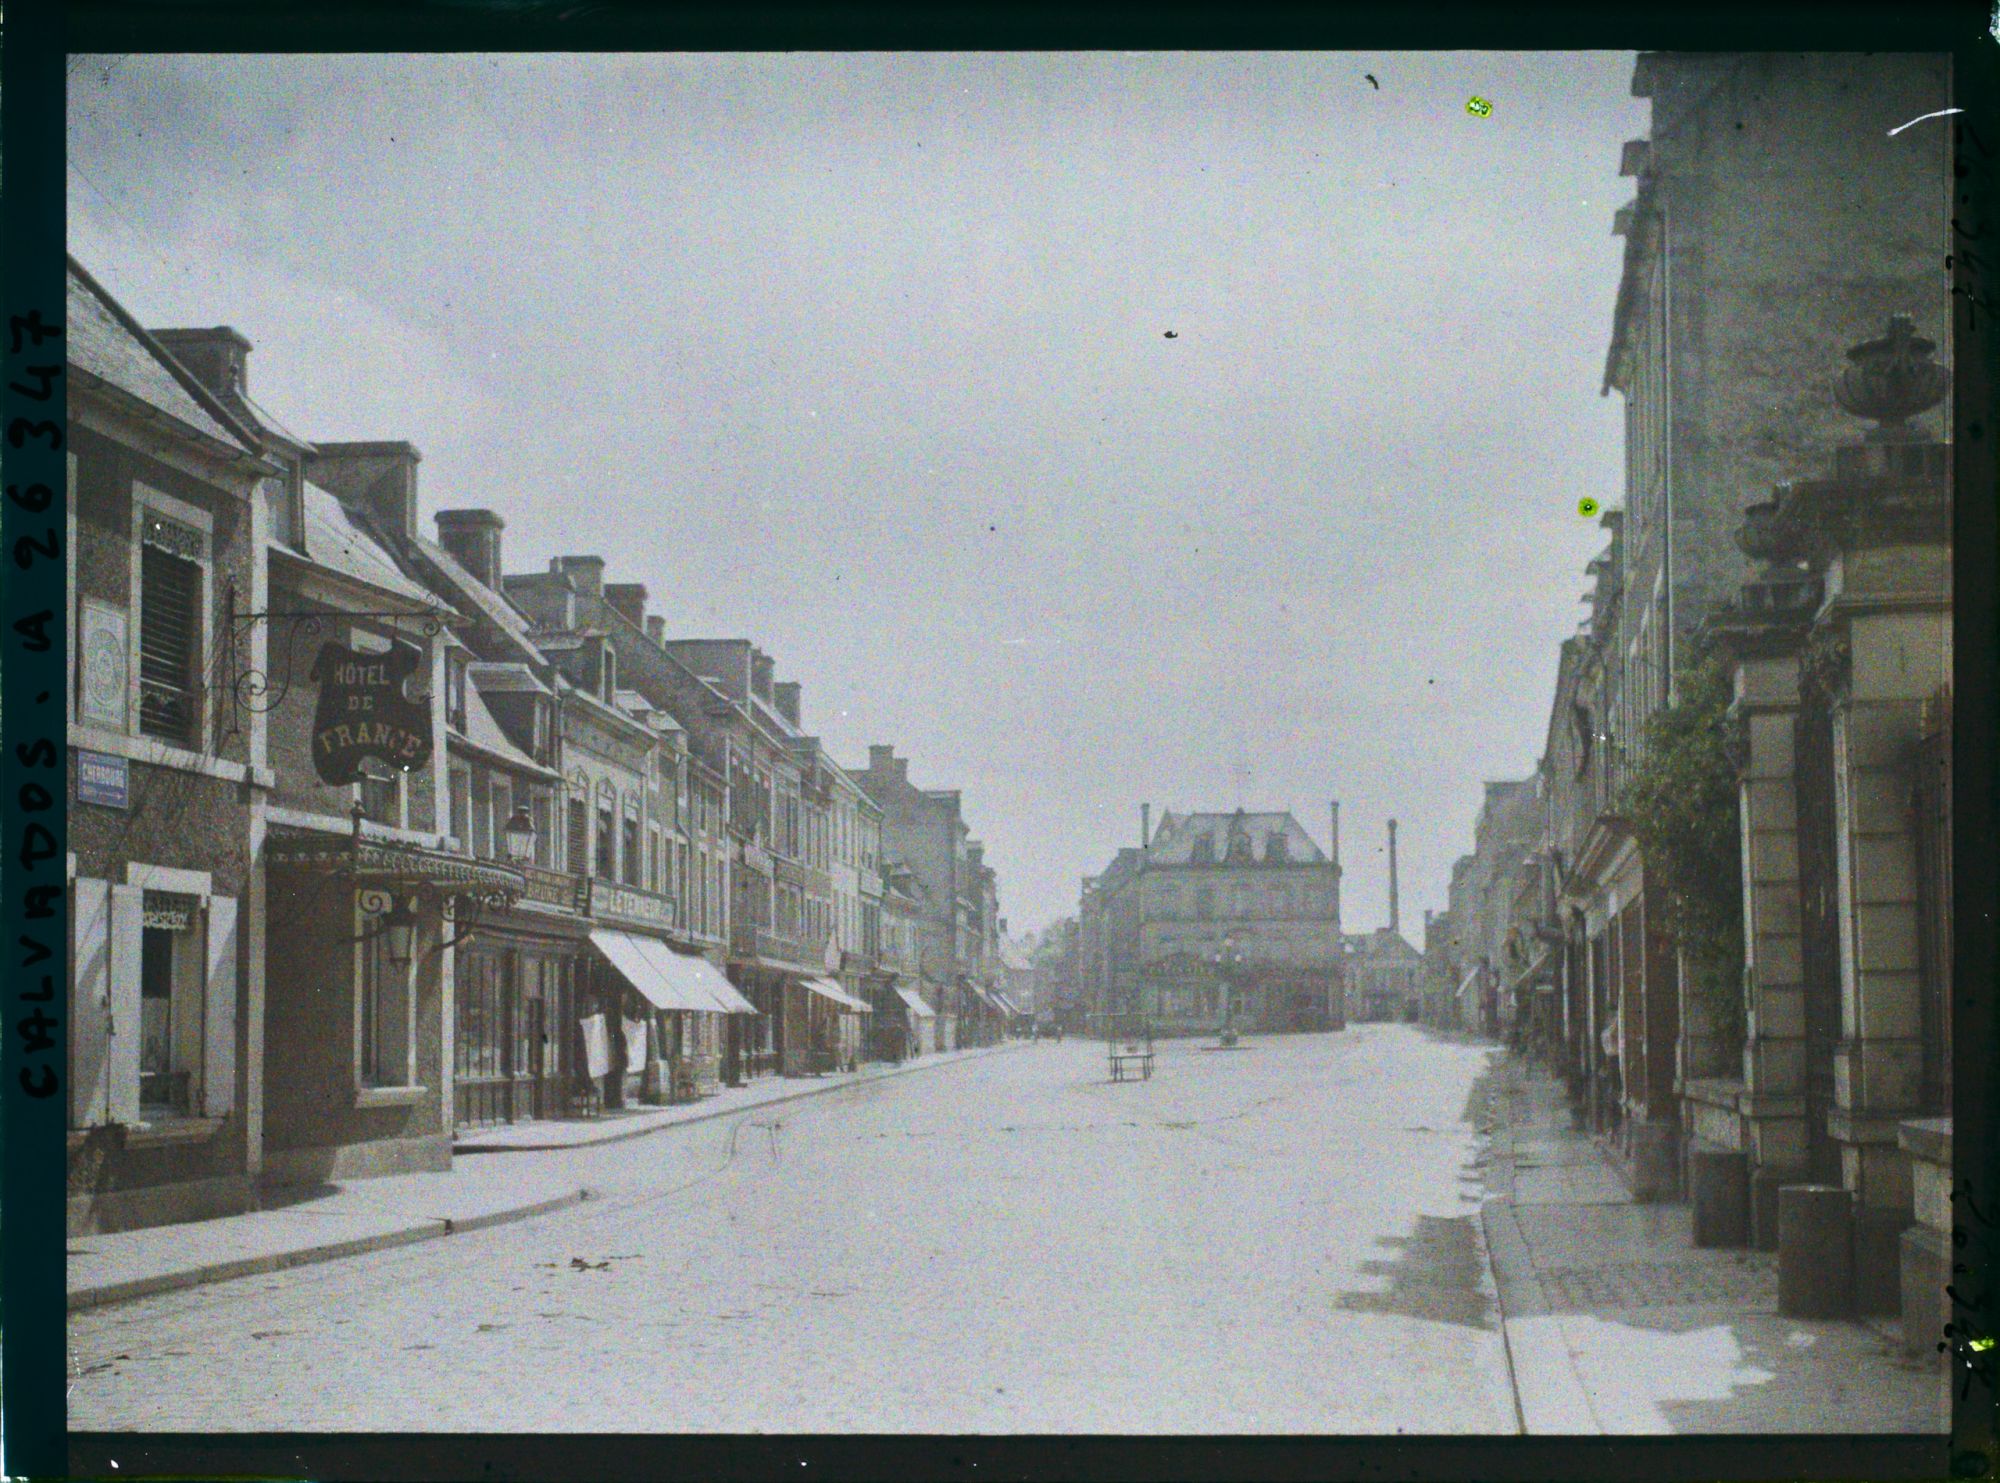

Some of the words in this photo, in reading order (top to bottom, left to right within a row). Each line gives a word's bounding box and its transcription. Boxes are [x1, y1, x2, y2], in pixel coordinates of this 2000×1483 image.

[12, 608, 55, 653] A
[347, 695, 373, 711] DE
[319, 722, 422, 758] FRANCE
